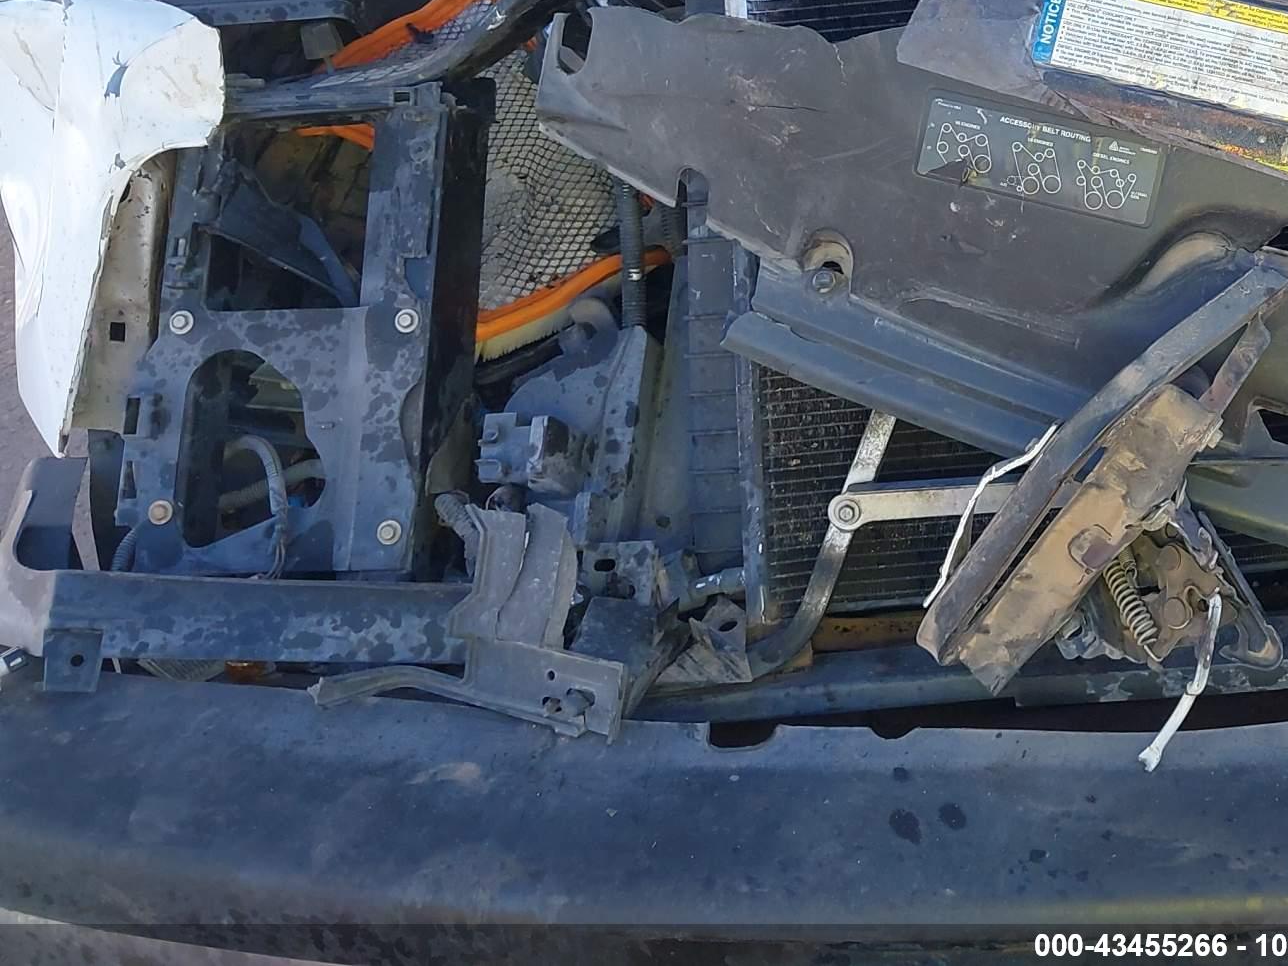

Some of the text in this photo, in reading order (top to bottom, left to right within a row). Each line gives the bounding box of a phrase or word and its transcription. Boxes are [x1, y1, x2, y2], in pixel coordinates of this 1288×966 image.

[1042, 126, 1060, 135] BELT
[1060, 130, 1091, 143] ROUTING
[1093, 152, 1108, 161] DIESEL
